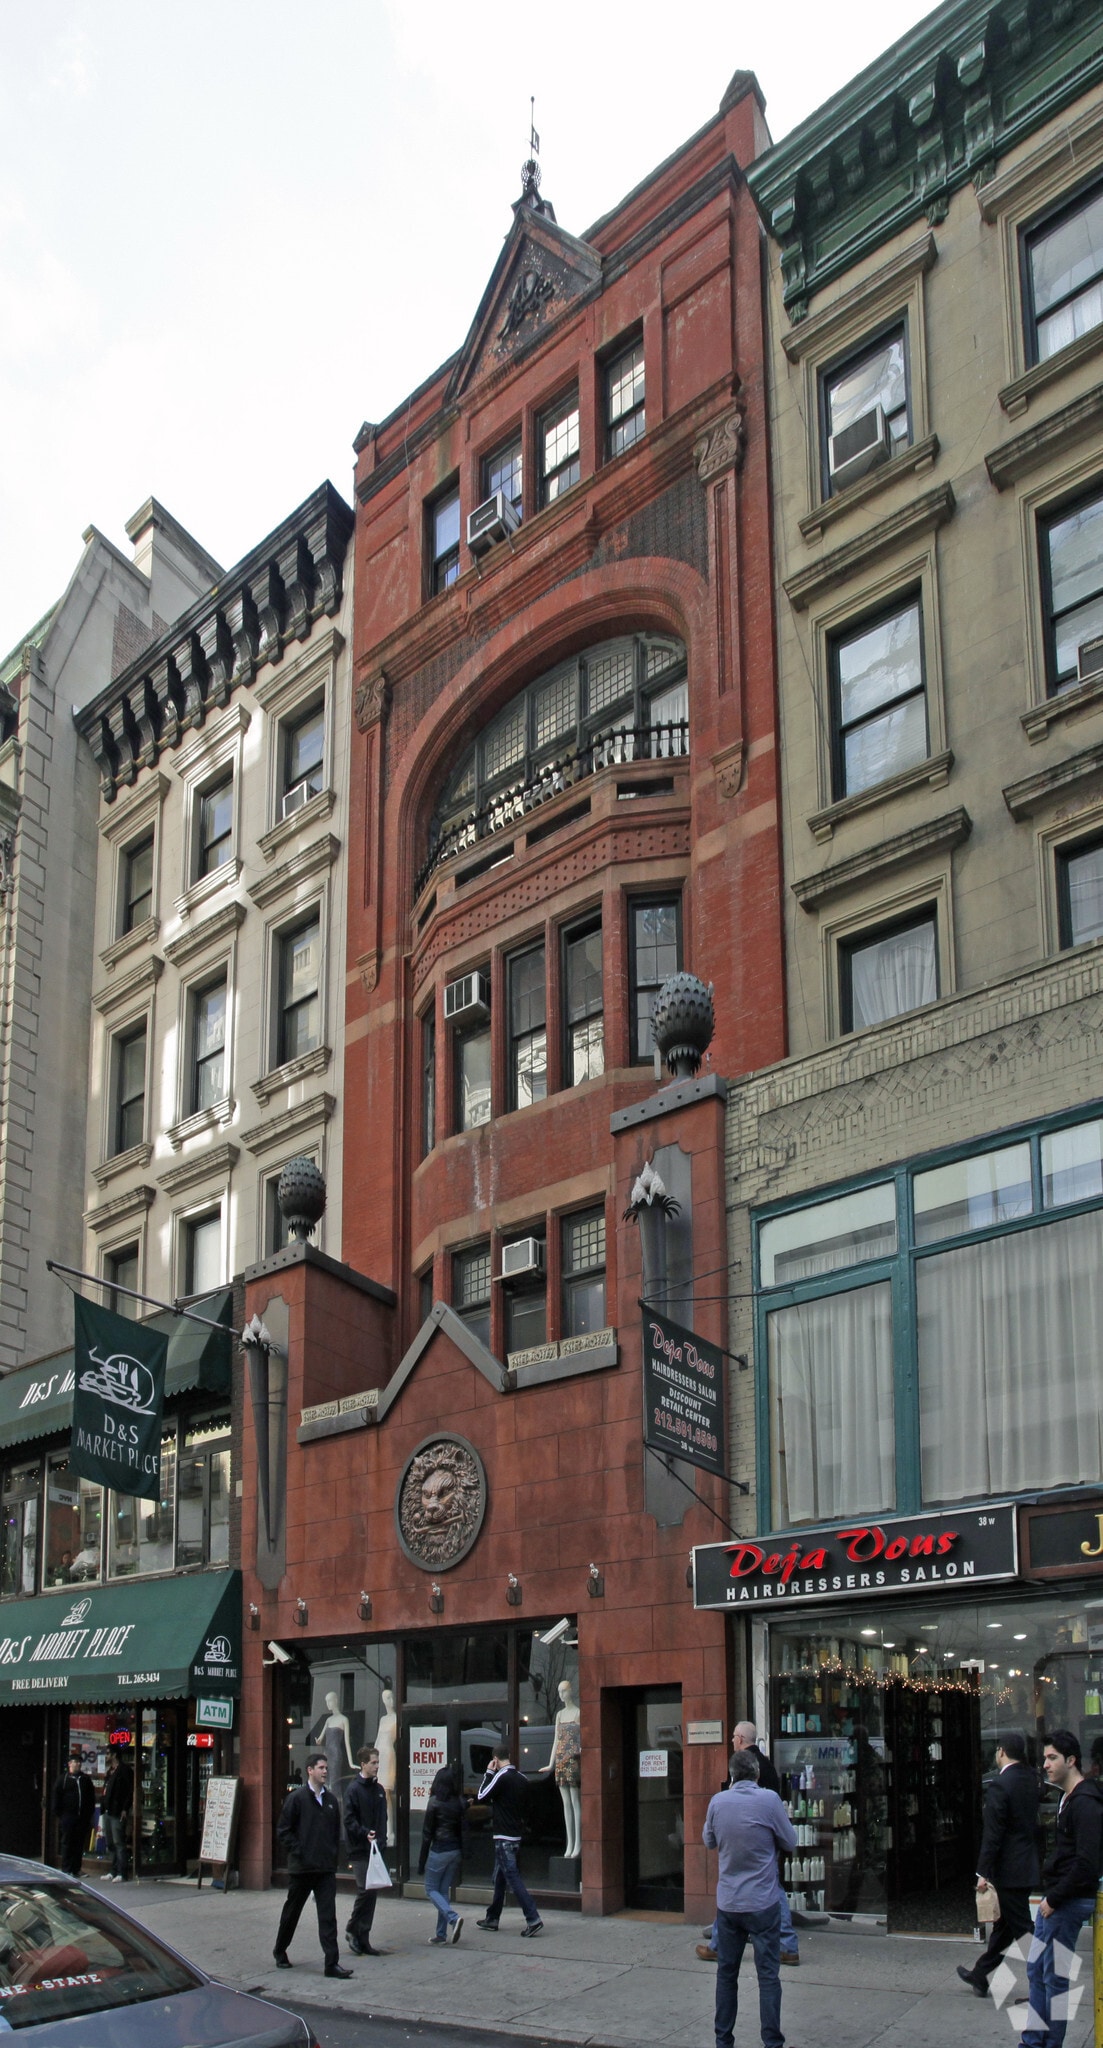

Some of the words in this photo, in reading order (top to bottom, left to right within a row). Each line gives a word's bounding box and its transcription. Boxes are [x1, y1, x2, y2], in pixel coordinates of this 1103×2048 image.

[649, 1323, 682, 1365] Deja
[19, 1374, 58, 1409] D&S
[651, 1358, 697, 1392] HAIRDRESSERS
[698, 1382, 717, 1401] SALON
[669, 1387, 702, 1411] DISCOUNT
[661, 1395, 684, 1415] RETAIL
[685, 1407, 710, 1428] CENTER
[104, 1413, 139, 1444] D&S
[77, 1427, 124, 1463] MARKET
[978, 1516, 987, 1526] 38
[722, 1542, 829, 1584] Deja
[835, 1526, 959, 1563] Vous
[726, 1571, 886, 1601] HAIRDRESSERS
[900, 1560, 975, 1583] SALON
[0, 1636, 32, 1664] D&S
[29, 1628, 90, 1662] MARKET
[83, 1624, 136, 1658] PLACE
[12, 1678, 31, 1690] FREE
[31, 1676, 69, 1689] DELIVERY
[117, 1674, 133, 1685] TEL.
[133, 1673, 160, 1684] 265-3434
[194, 1665, 204, 1675] D&S
[207, 1666, 224, 1677] MARKET
[225, 1668, 237, 1678] PLACE
[203, 1705, 227, 1719] ATM
[109, 1731, 130, 1745] OPEN
[420, 1738, 437, 1748] FOR
[413, 1752, 444, 1764] RENT
[41, 1974, 102, 1989] STATE
